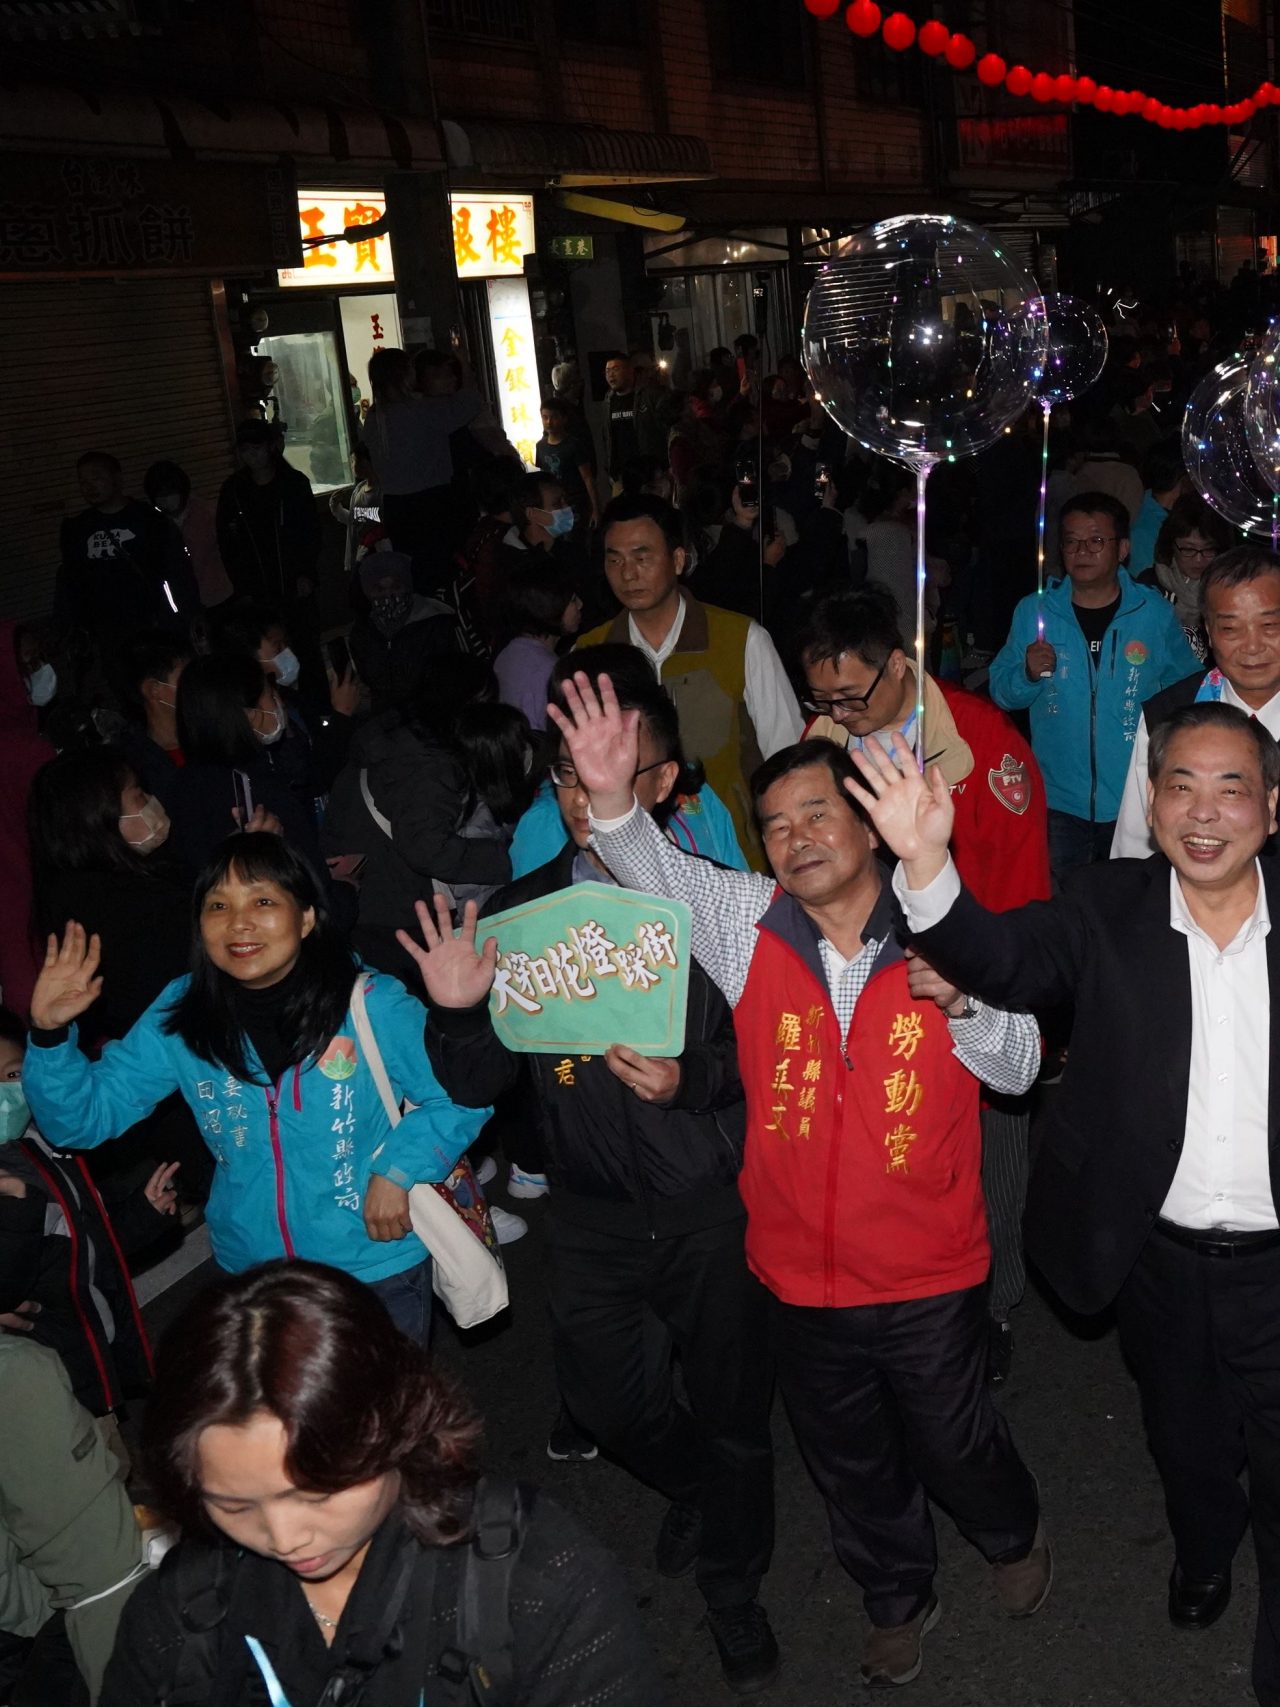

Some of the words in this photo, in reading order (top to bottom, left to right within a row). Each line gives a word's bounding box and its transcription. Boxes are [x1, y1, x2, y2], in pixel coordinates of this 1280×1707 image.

[1123, 666, 1141, 742] 新竹縣政府
[949, 783, 967, 796] TV
[883, 1011, 927, 1175] 勞動黨
[329, 1083, 360, 1211] 新竹縣政府
